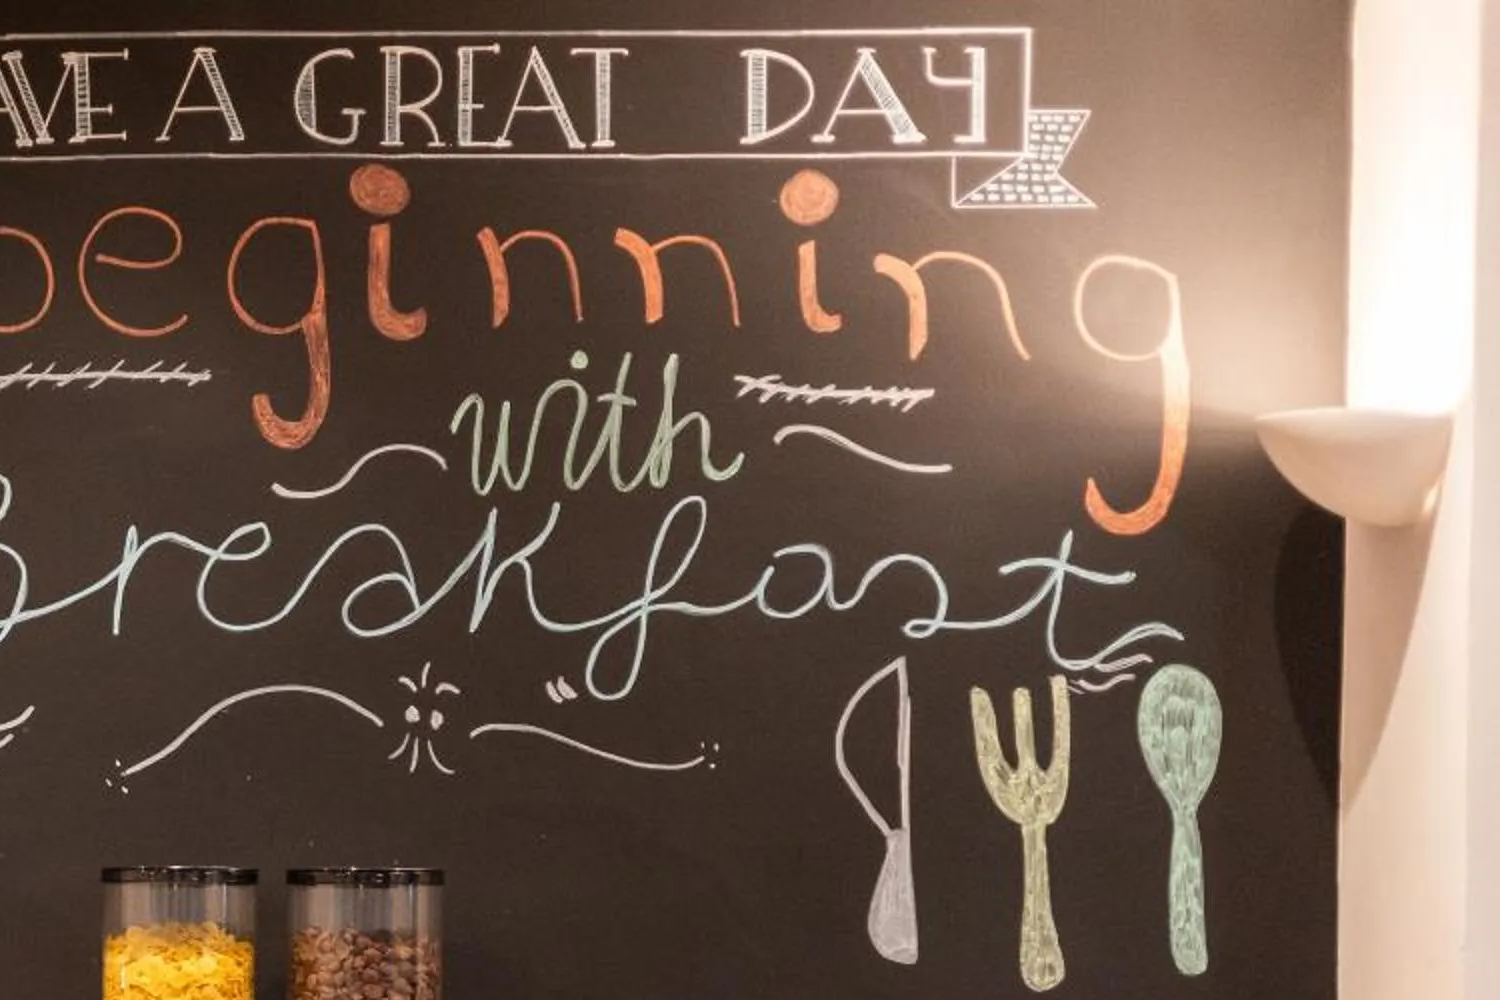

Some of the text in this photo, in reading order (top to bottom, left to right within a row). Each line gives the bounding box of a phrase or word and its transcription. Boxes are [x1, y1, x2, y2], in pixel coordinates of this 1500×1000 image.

[155, 47, 245, 142] A
[293, 43, 629, 149] GREAT
[739, 45, 987, 146] DAY
[450, 351, 745, 496] with
